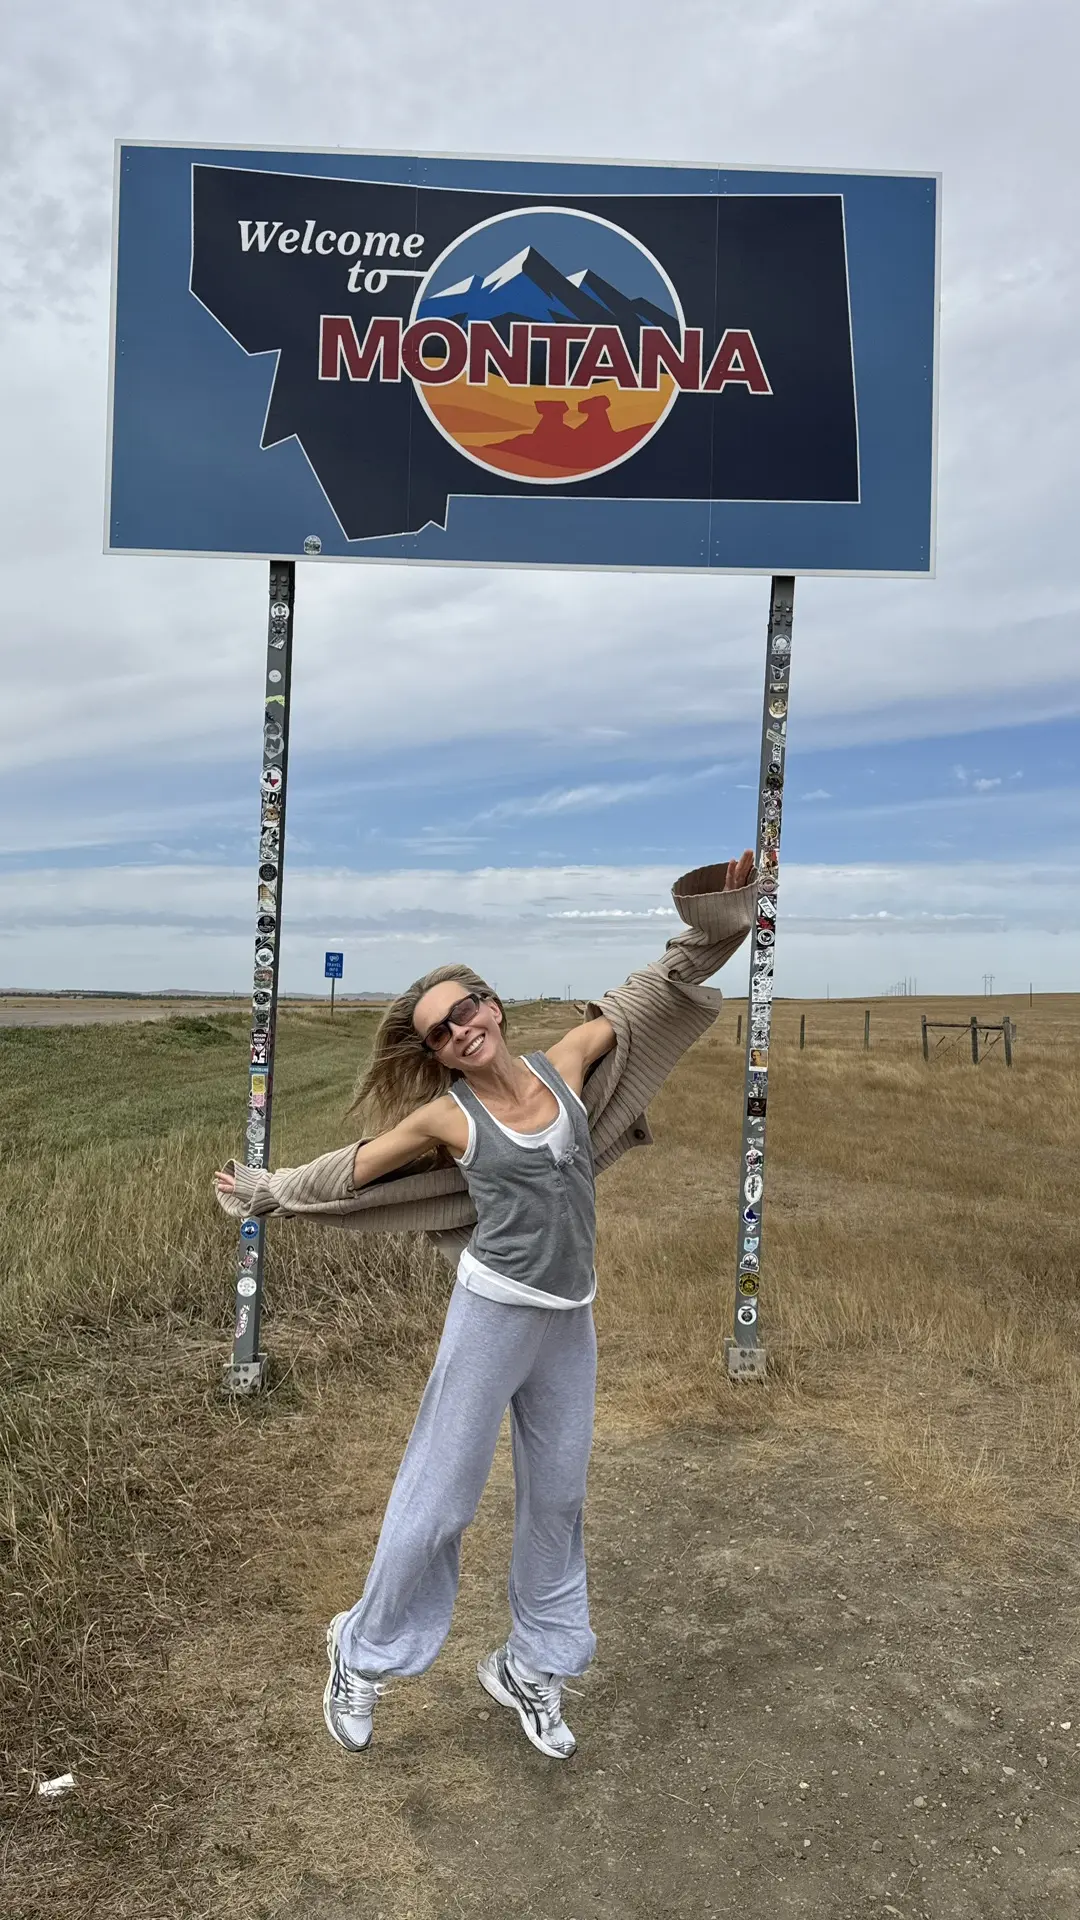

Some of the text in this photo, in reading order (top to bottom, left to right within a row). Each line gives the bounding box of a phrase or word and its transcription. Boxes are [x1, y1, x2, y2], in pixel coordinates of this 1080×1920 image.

[237, 219, 425, 258] Welcome
[347, 260, 388, 294] to
[318, 314, 774, 396] MONTANA
